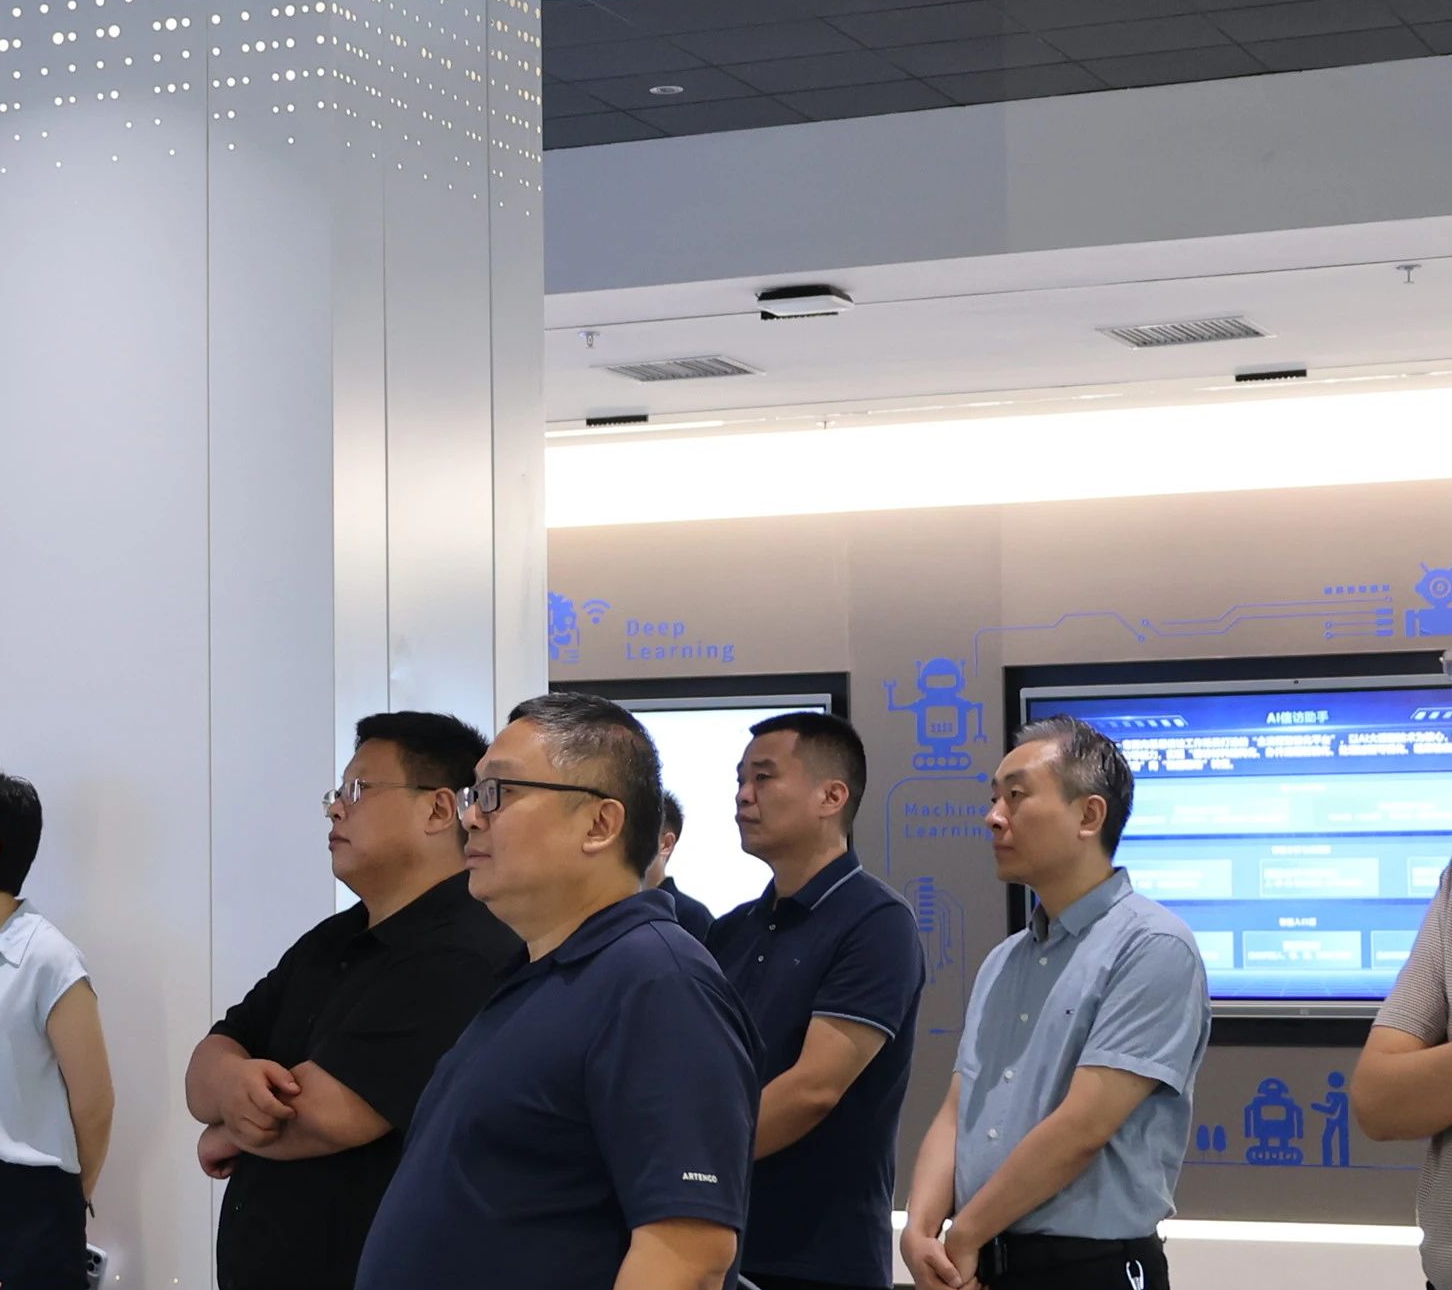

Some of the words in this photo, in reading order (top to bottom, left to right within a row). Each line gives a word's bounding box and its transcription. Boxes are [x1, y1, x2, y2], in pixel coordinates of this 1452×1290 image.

[626, 620, 685, 639] Deep
[626, 641, 735, 662] Learning
[904, 800, 990, 817] Machine
[904, 821, 995, 842] Learning
